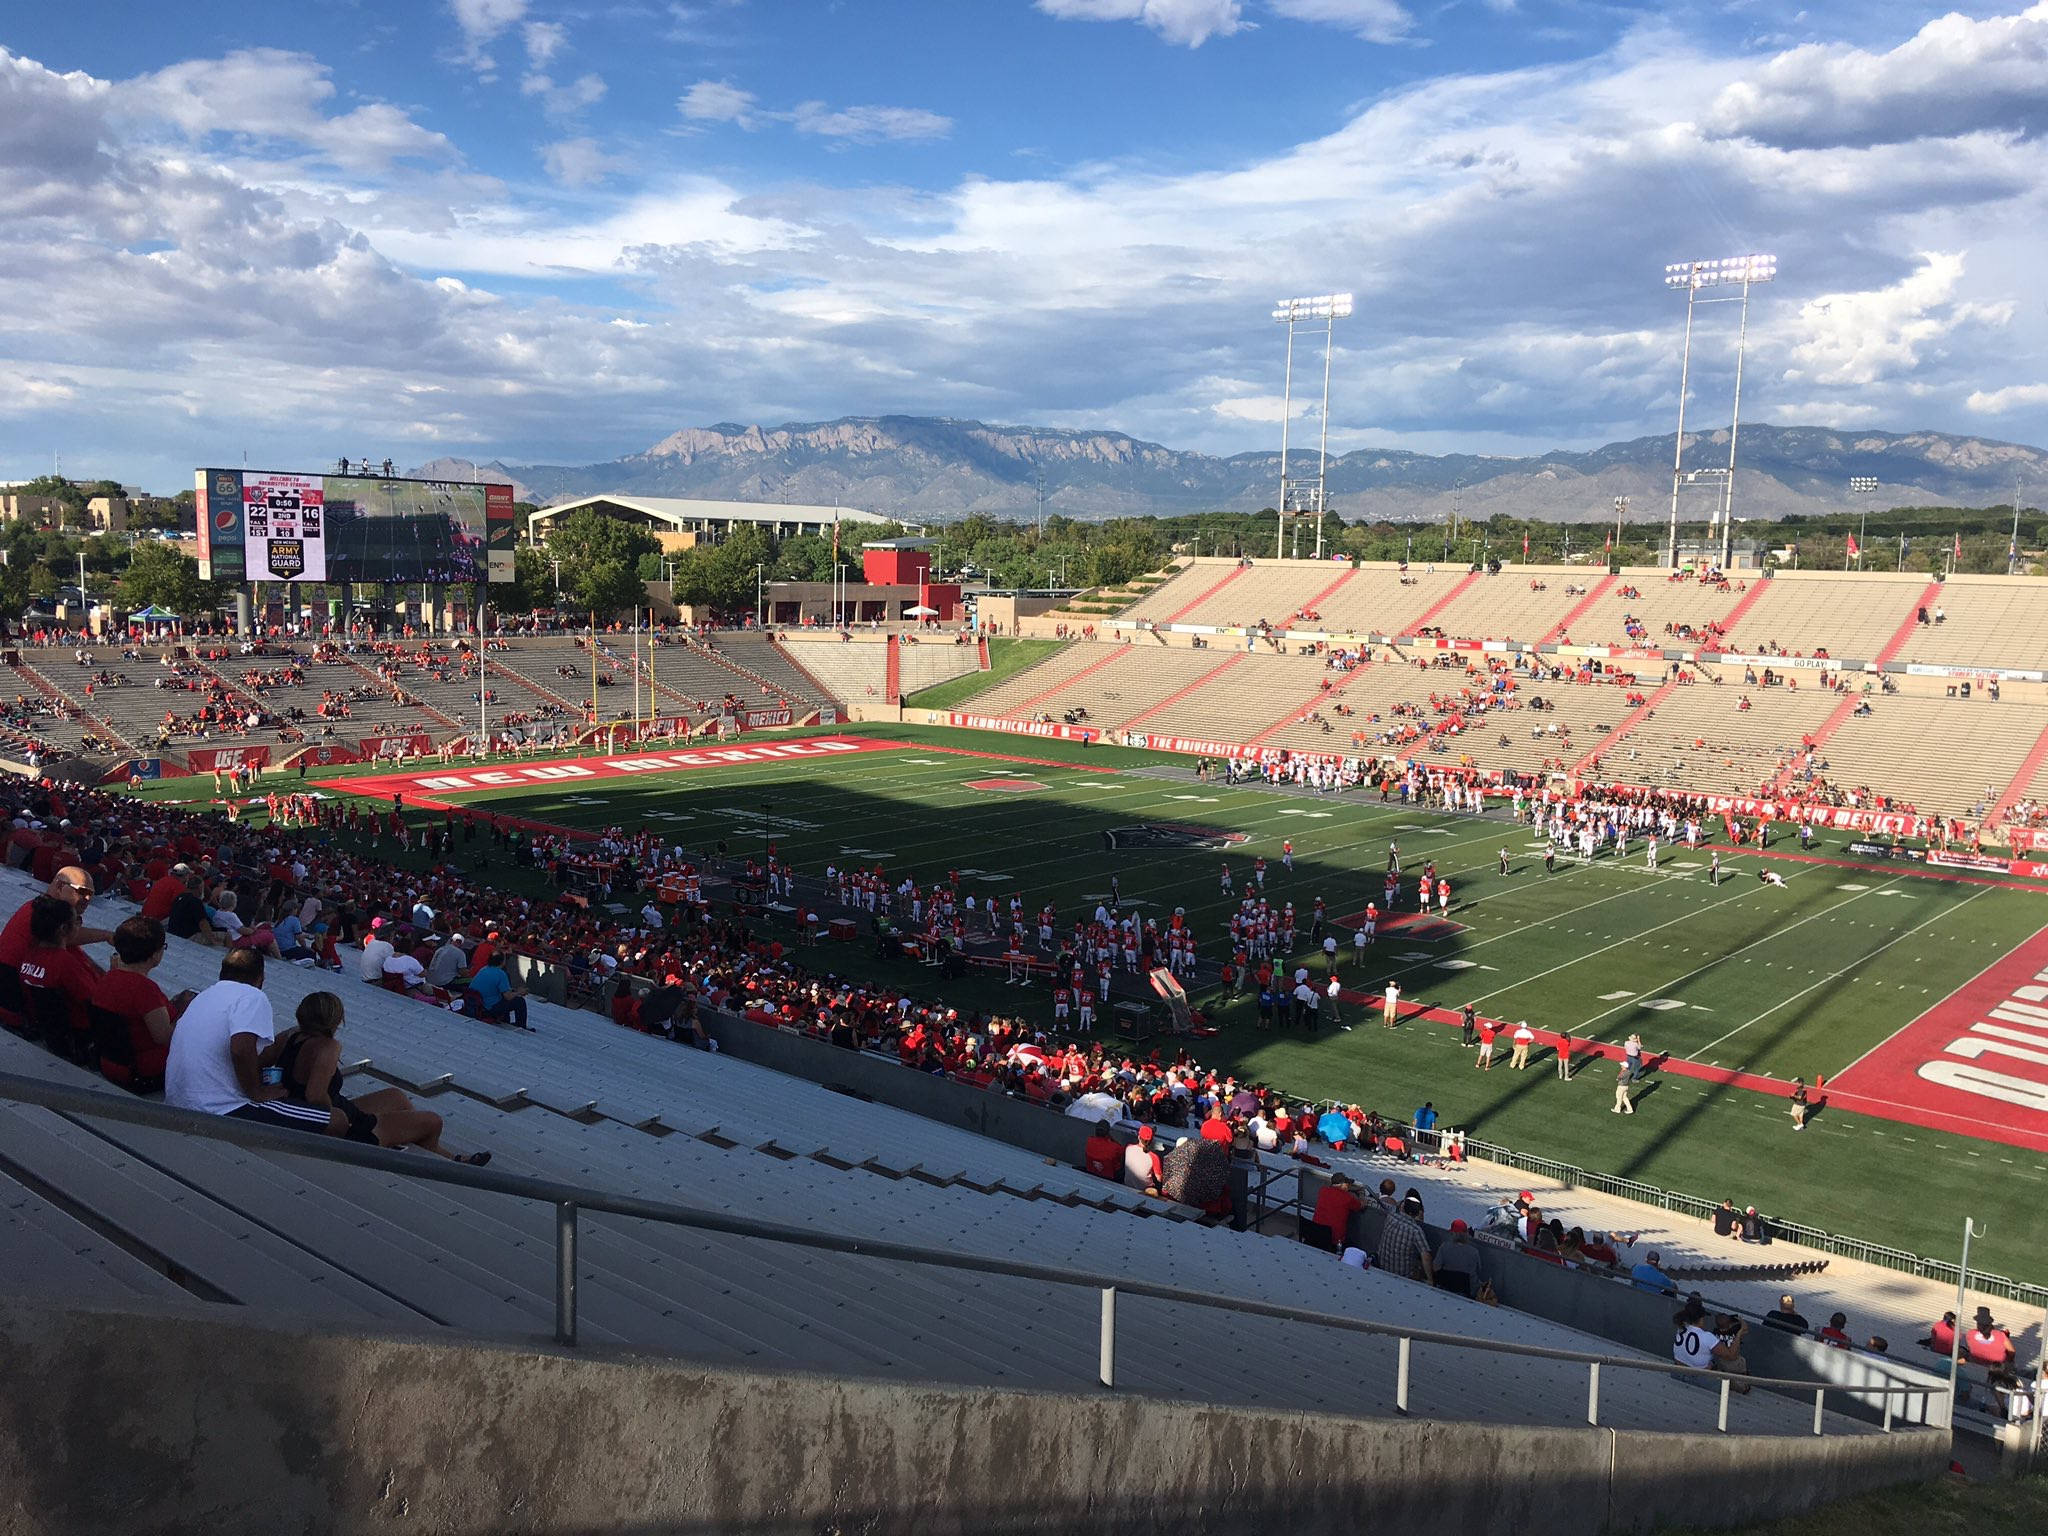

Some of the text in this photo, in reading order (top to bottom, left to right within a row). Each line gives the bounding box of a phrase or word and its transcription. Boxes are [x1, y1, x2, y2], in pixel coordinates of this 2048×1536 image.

[219, 484, 233, 493] 66
[250, 506, 266, 517] 22
[303, 508, 319, 519] 16
[271, 546, 299, 555] ARMY
[271, 559, 301, 567] GUARD
[750, 710, 791, 728] MEXICO
[1152, 736, 1173, 749] THE
[1175, 738, 1240, 757] UNIVERSITY
[1243, 747, 1259, 758] OF
[413, 740, 860, 791] NEW MEXICO
